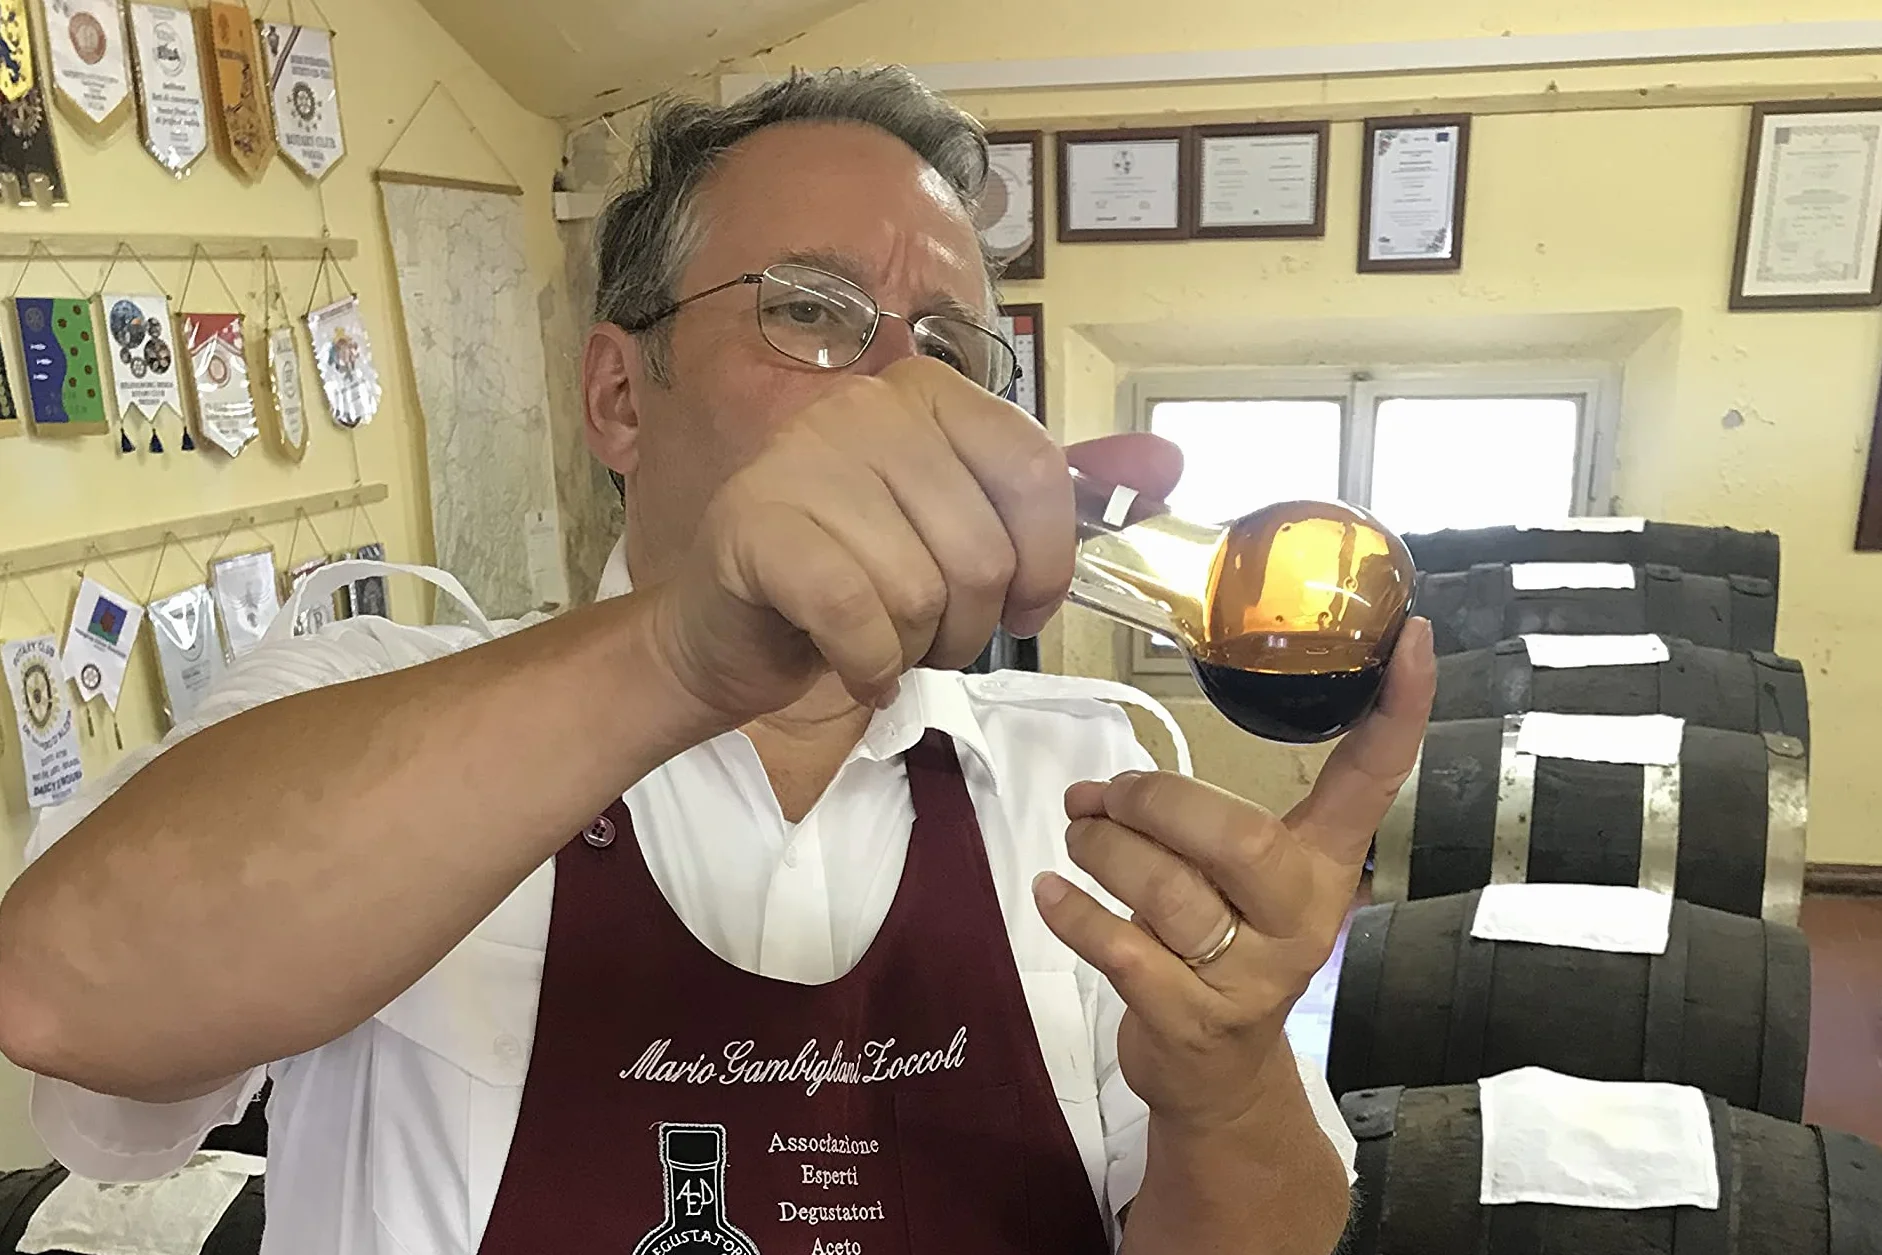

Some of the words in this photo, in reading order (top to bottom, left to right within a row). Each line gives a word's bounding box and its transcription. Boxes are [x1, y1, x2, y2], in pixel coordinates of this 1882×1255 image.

[619, 1038, 717, 1084] Mario
[719, 1038, 861, 1097] Gambigliani
[862, 1026, 967, 1083] Zoccoli
[768, 1132, 879, 1154] Associazione
[801, 1165, 859, 1189] Esperti
[778, 1201, 885, 1225] Degustatori
